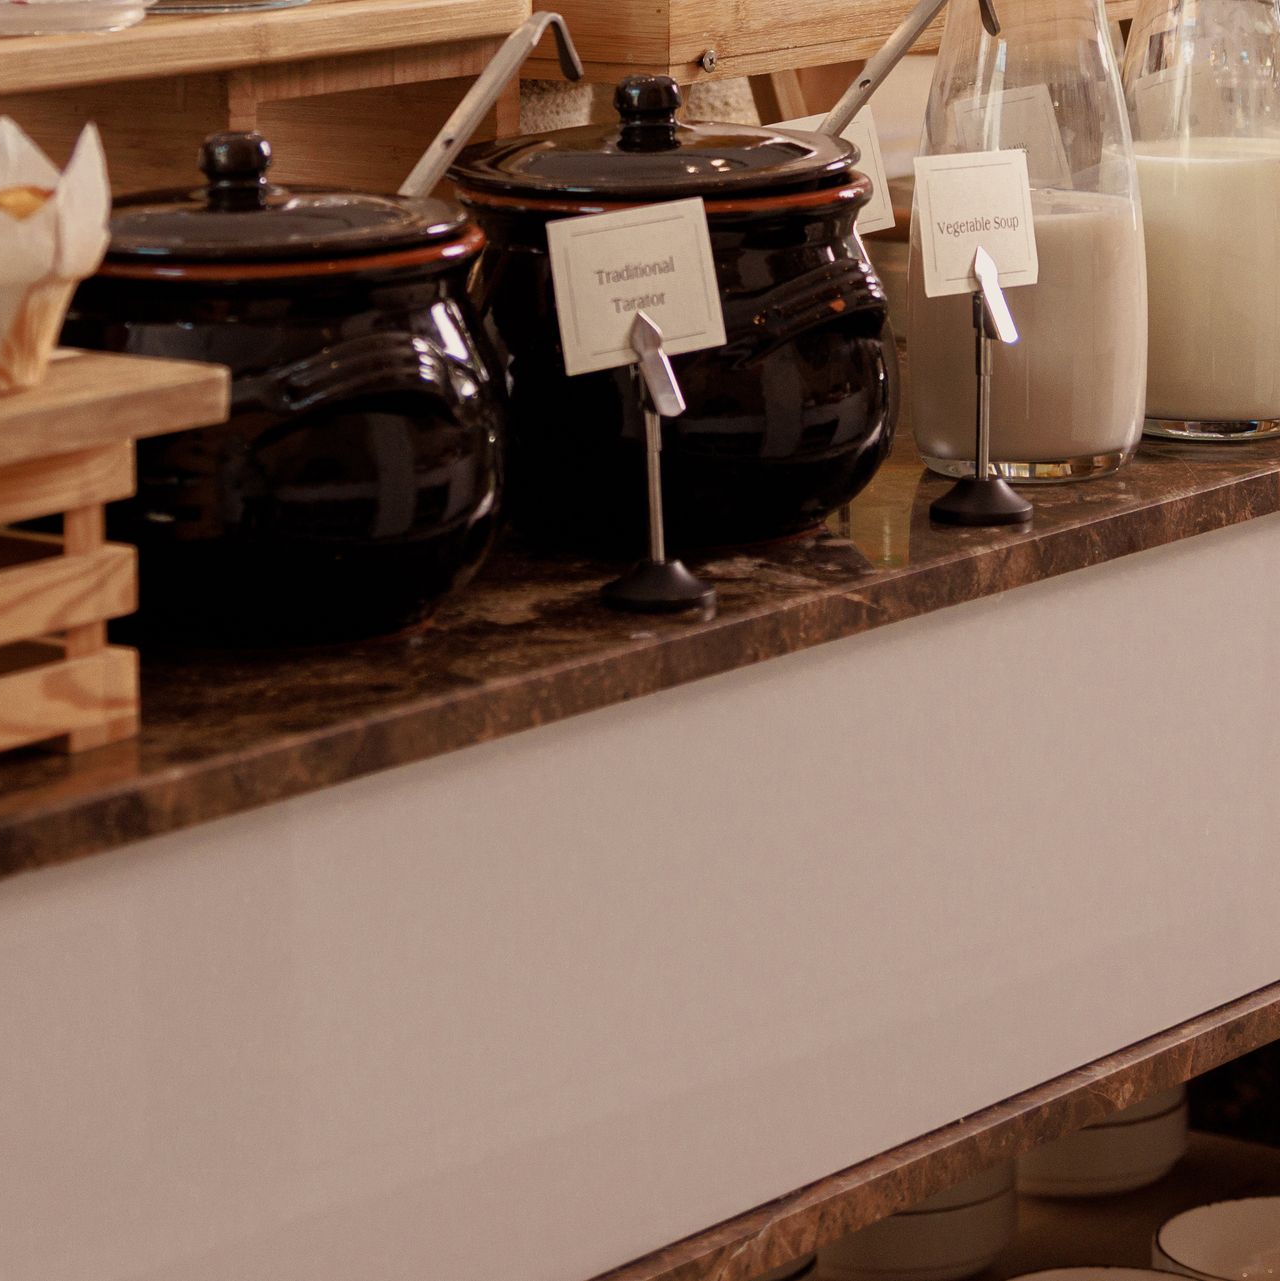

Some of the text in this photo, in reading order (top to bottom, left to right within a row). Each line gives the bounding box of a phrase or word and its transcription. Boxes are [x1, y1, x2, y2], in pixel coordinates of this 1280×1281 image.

[937, 216, 1019, 237] Vegetable Soup
[595, 256, 675, 285] Traditional
[611, 292, 665, 313] Tarator
